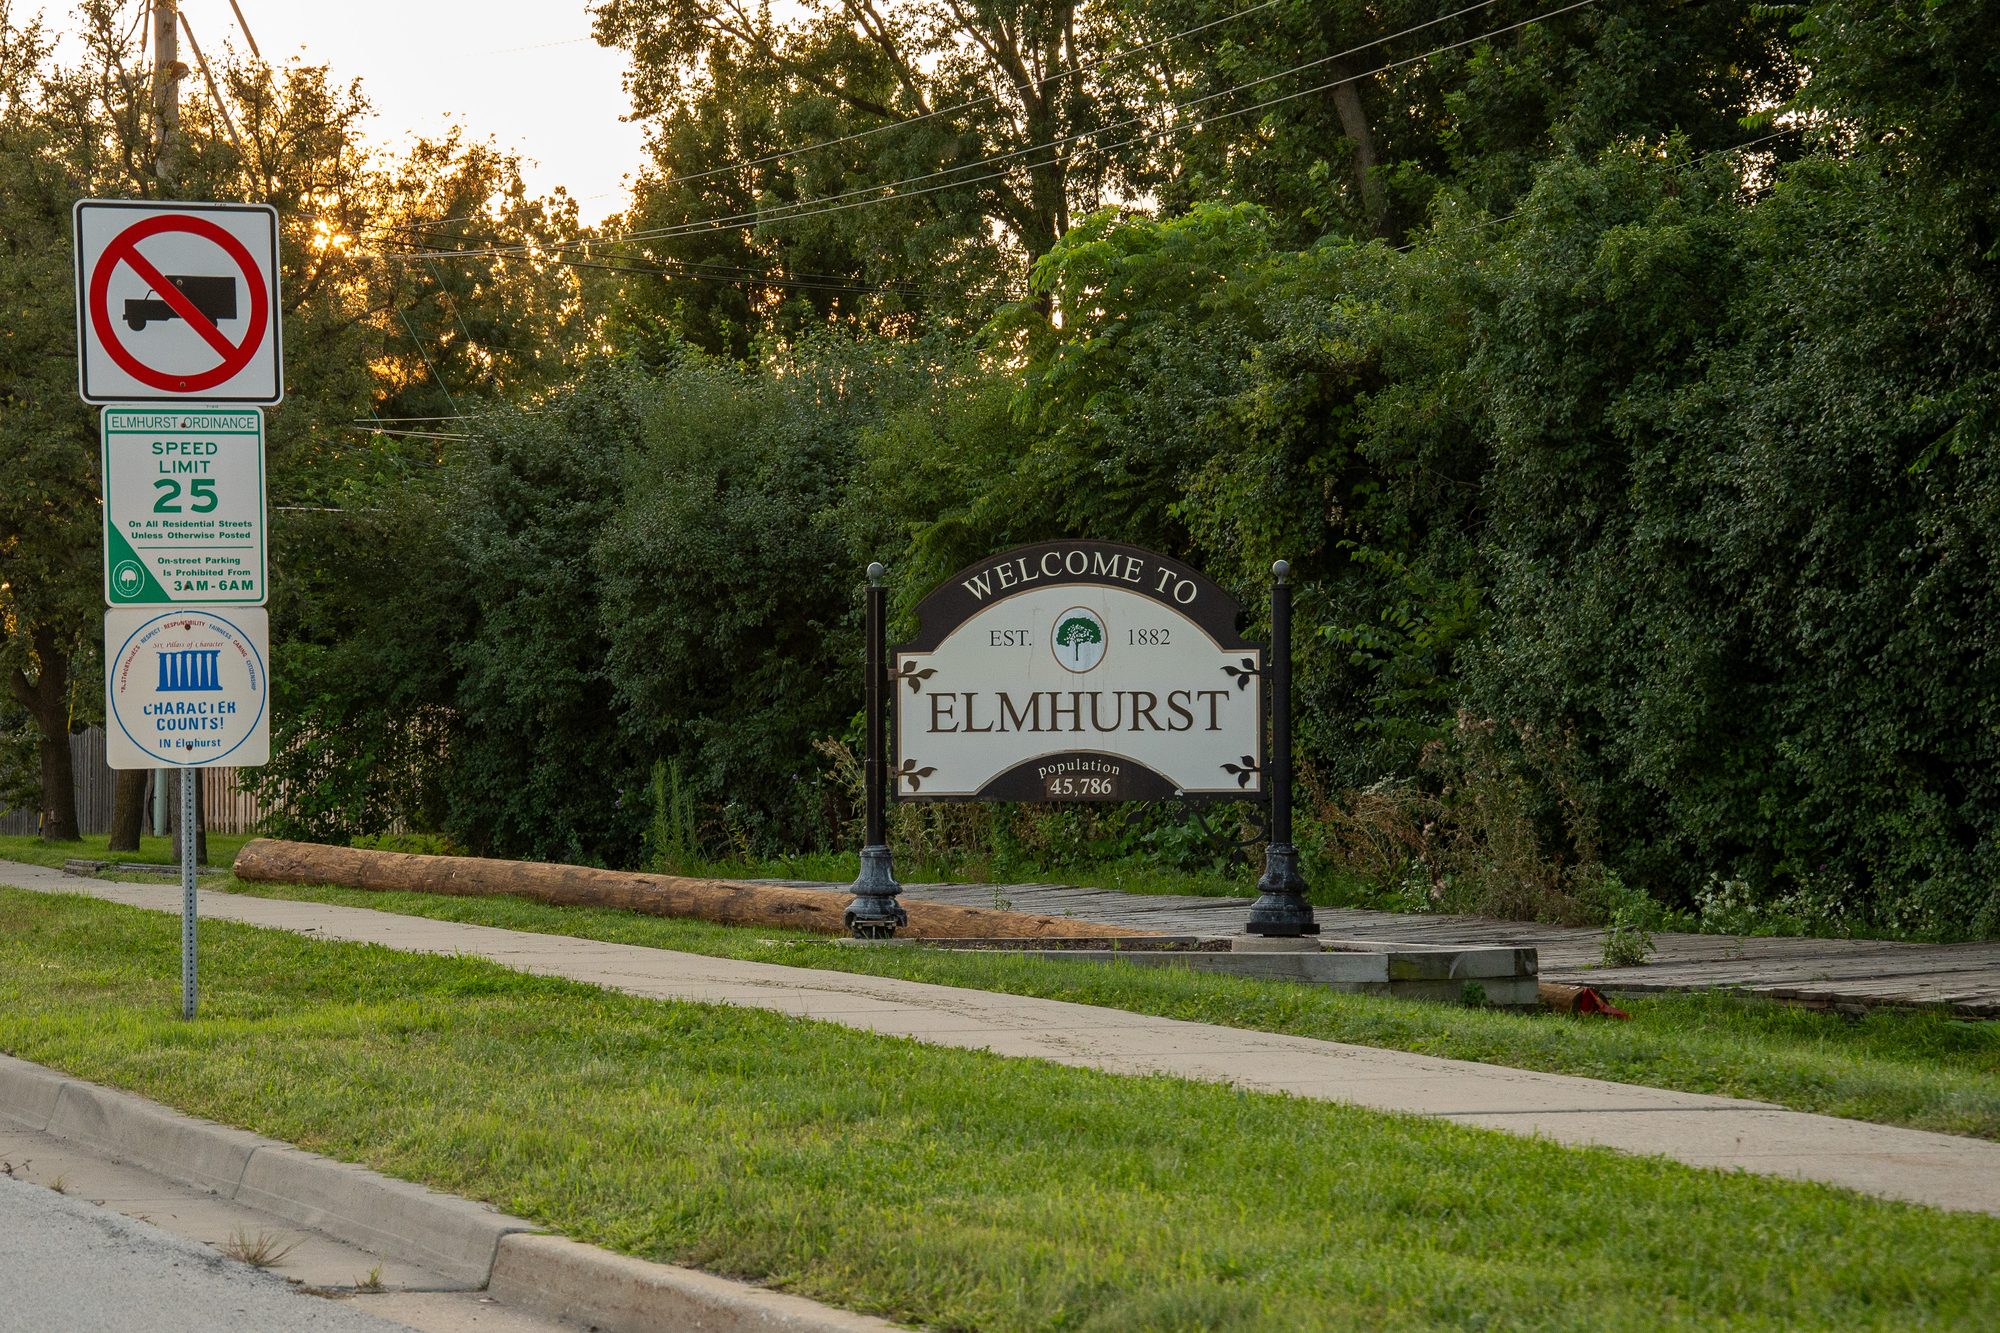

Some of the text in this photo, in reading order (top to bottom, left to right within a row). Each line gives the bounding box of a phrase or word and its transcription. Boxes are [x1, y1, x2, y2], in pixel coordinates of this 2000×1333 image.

[112, 416, 255, 429] ELMHURST ORDINANCE
[152, 441, 218, 455] SPEED
[159, 460, 211, 474] LIMIT
[153, 478, 219, 513] 25
[128, 520, 253, 528] On All Residential Streets
[219, 531, 251, 539] Posted
[157, 557, 241, 566] On-street Parking
[163, 568, 251, 577] Is Prohibited From
[961, 550, 1198, 604] WELCOME TO
[989, 628, 1171, 647] EST. 1882
[186, 641, 194, 649] of
[140, 627, 161, 644] RESPECT
[163, 619, 206, 630] RESPONSIBILITY
[208, 624, 232, 640] FAIRNESS
[232, 639, 248, 658] CARING
[246, 659, 257, 691] CITIZENSHIP
[925, 689, 1230, 733] ELMHURST
[156, 717, 224, 731] COUNTS!
[159, 738, 221, 748] IN Elmhurst
[1038, 758, 1121, 779] population
[1049, 777, 1112, 796] 45,786
